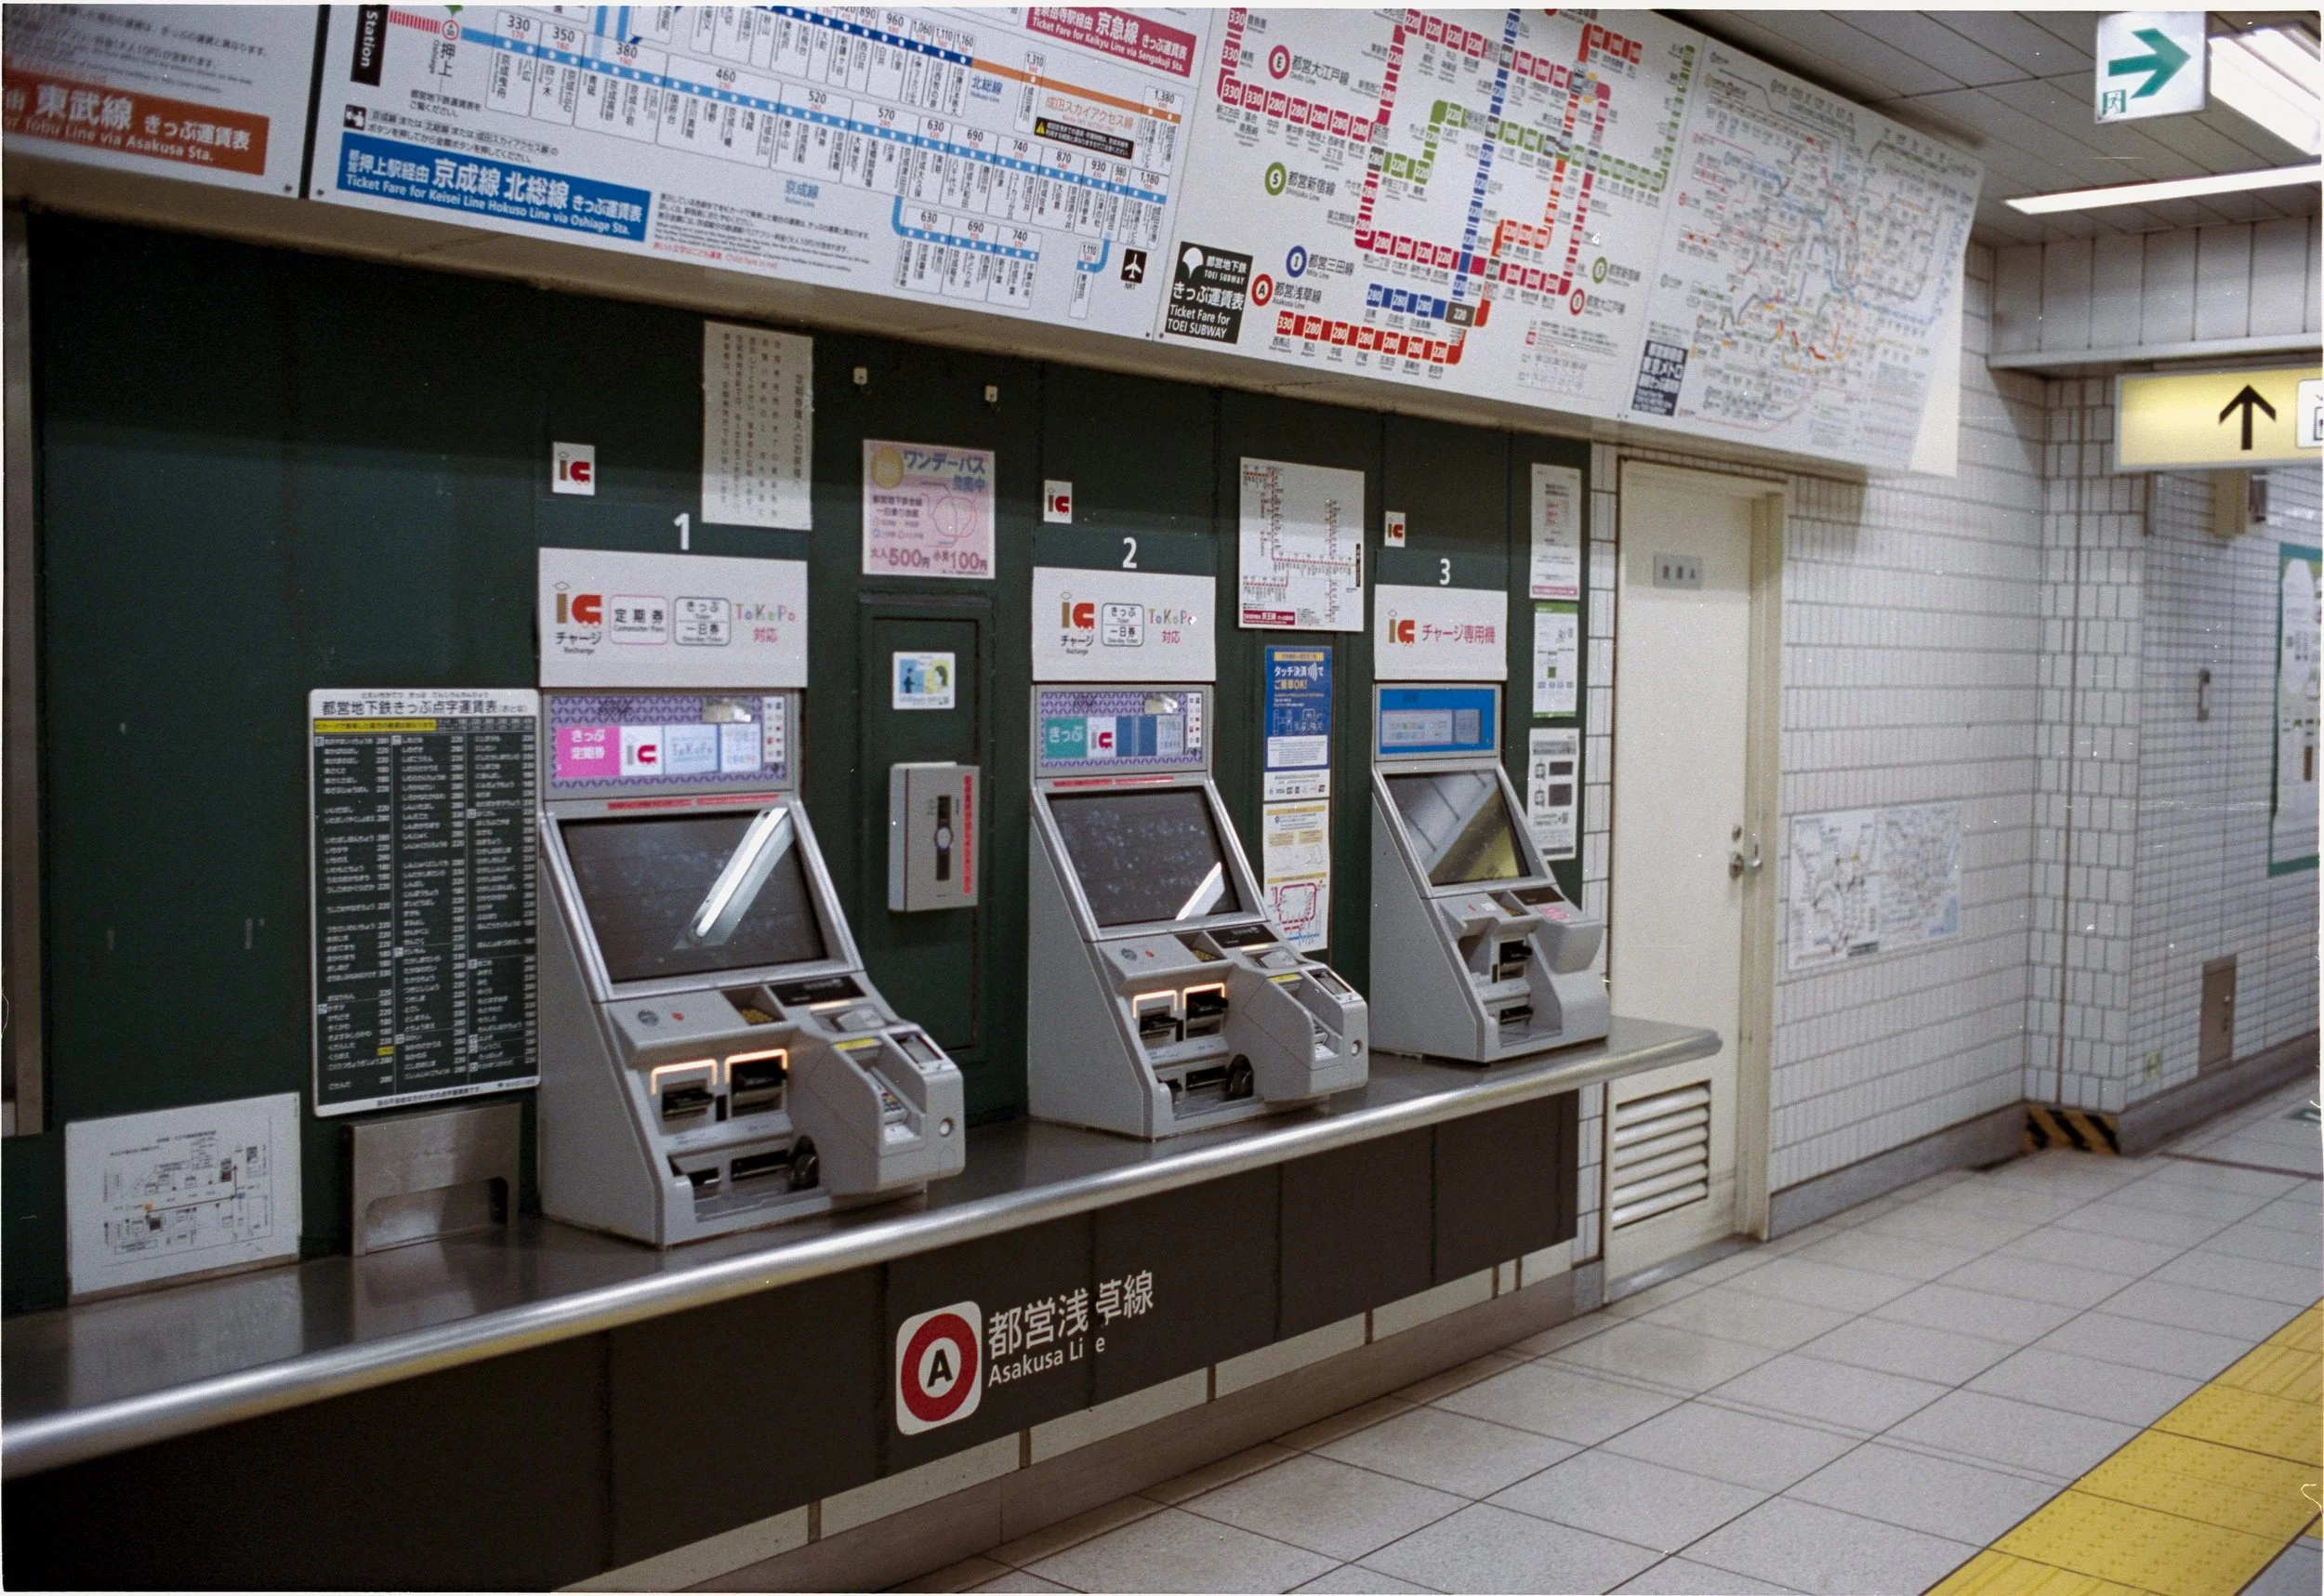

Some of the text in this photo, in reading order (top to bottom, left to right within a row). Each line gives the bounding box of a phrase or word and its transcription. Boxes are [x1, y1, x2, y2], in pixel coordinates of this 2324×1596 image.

[859, 7, 877, 19] 890
[1228, 11, 1246, 26] 330
[508, 15, 531, 32] 330
[887, 14, 905, 27] 960
[552, 27, 574, 43] 350
[913, 21, 932, 35] 1,060
[936, 28, 953, 42] 1,110
[360, 9, 378, 68] Station
[957, 33, 974, 47] 1,160
[1096, 12, 1187, 60] 京急線 きっぷ運賃表
[616, 43, 638, 59] 380
[1033, 17, 1184, 72] Ticket Fare for Keikyu Line via Sengakuji Sta.
[438, 40, 456, 77] 押上
[1026, 53, 1044, 67] 1,310
[1222, 47, 1238, 61] 330
[1276, 57, 1283, 68] E
[716, 68, 736, 83] 460
[1292, 55, 1351, 86] 都営大江戸線
[971, 75, 1003, 94] 北総線
[1222, 84, 1240, 97] 330
[808, 90, 827, 104] 520
[1154, 89, 1175, 104] 1,380
[1246, 91, 1262, 106] 330
[36, 85, 251, 152] 東武線 きっぷ運賃表
[878, 107, 895, 121] 570
[1045, 97, 1135, 128] 成田スカイアクセス線
[928, 119, 944, 132] 630
[967, 129, 984, 142] 690
[65, 125, 99, 140] Line
[101, 132, 123, 146] via
[126, 135, 185, 157] Asakusa
[189, 144, 213, 162] Sta.
[1013, 140, 1028, 152] 740
[1056, 152, 1072, 165] 870
[1091, 160, 1106, 172] 930
[1116, 165, 1127, 178] 980
[1141, 172, 1160, 185] 1,180
[1272, 173, 1279, 185] S
[1287, 171, 1336, 196] 都営新宿線
[433, 157, 501, 198] 京成線
[505, 171, 570, 212] 北総線
[572, 193, 642, 223] きっぷ運賃表
[346, 173, 630, 236] Ticket Fare for Keisei Line Hokuso Line via Oshiage Sta.
[920, 211, 938, 224] 630
[968, 221, 984, 233] 690
[1012, 230, 1028, 243] 740
[1083, 244, 1097, 257] 1,110
[1206, 256, 1248, 274] 都営地下鉄
[1293, 257, 1300, 268] I
[1308, 254, 1355, 276] 都営三田線
[1204, 270, 1245, 285] TOEI SUBWAY
[1124, 283, 1136, 291] NRT
[1258, 284, 1266, 296] A
[1274, 282, 1322, 304] 都営浅草線
[1172, 281, 1244, 311] きっぷ運賃表
[1367, 288, 1382, 301] 280
[1393, 295, 1406, 307] 280
[1169, 304, 1231, 325] Ticket Fare for
[1453, 309, 1467, 321] 220
[1167, 318, 1228, 340] TOEI SUBWAY
[1277, 318, 1293, 330] 330
[1306, 323, 1321, 335] 280
[1333, 327, 1347, 340] 280
[1359, 333, 1373, 345] 280
[1385, 337, 1399, 350] 280
[904, 450, 986, 475] ワンデーパス
[673, 512, 690, 550] 1
[1122, 536, 1138, 569] 2
[1439, 558, 1451, 586] 3
[685, 600, 720, 613] きっぷ
[1111, 606, 1136, 617] きっぷ
[614, 609, 666, 624] 定期券
[686, 624, 720, 636] 一日券
[753, 628, 778, 643] 対応
[1110, 627, 1136, 638] 一日券
[1161, 630, 1181, 644] 対応
[1421, 623, 1496, 645] チャージ専用機
[555, 631, 603, 645] チャージ
[1061, 635, 1094, 647] チャージ
[323, 700, 498, 716] 都営地下鉄きっぷ点字運賃表
[571, 729, 605, 743] きっぷ
[1048, 725, 1084, 744] きっぷ
[987, 1269, 1155, 1361] 都営浅草線
[926, 1348, 953, 1389] A
[987, 1335, 1106, 1388] Asakusa Lie
